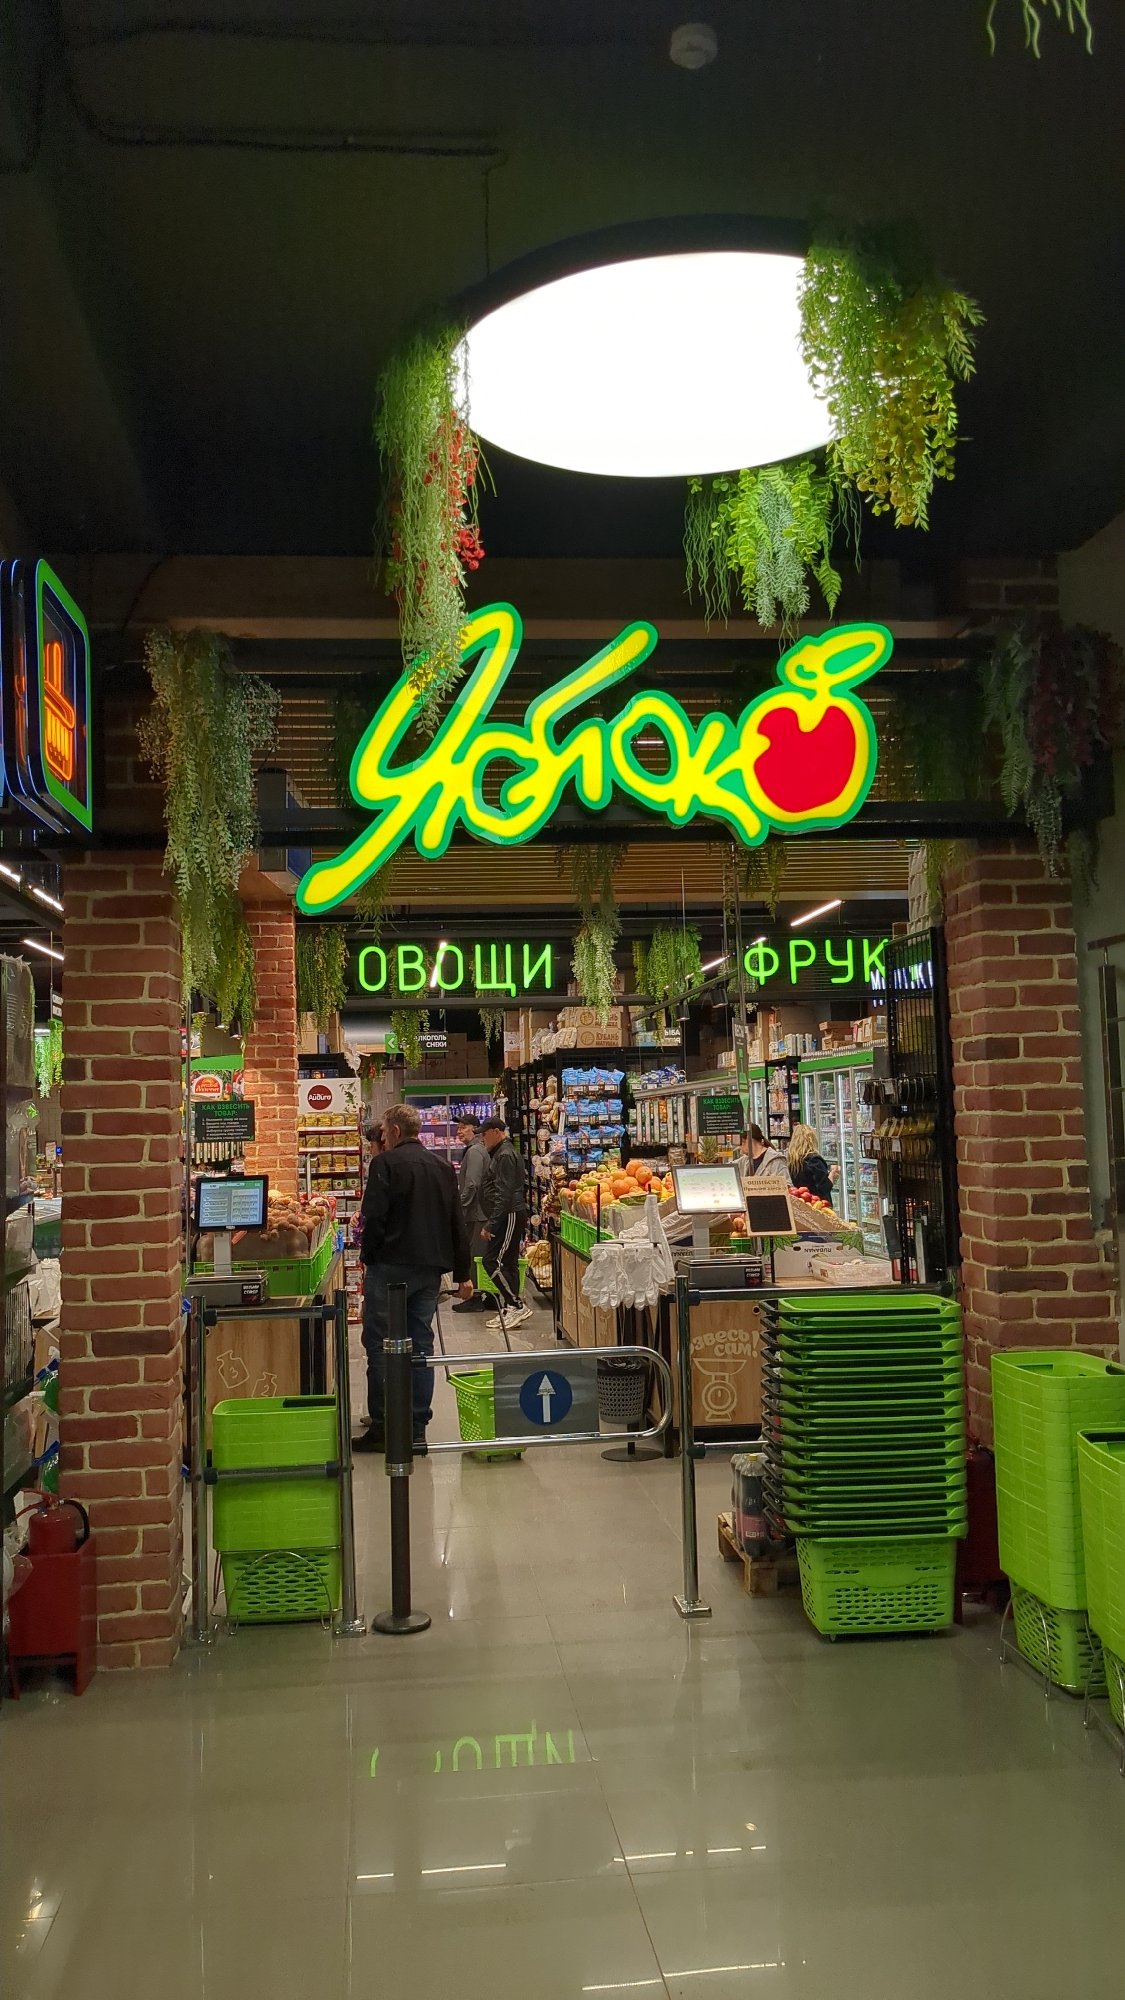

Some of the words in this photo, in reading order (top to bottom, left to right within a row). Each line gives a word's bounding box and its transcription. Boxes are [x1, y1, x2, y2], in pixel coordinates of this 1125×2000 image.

[358, 943, 552, 997] ОВОЩИ
[415, 1034, 447, 1042] ЛКОГОЛЬ
[230, 1366, 239, 1379] 3
[260, 1384, 269, 1397] 2
